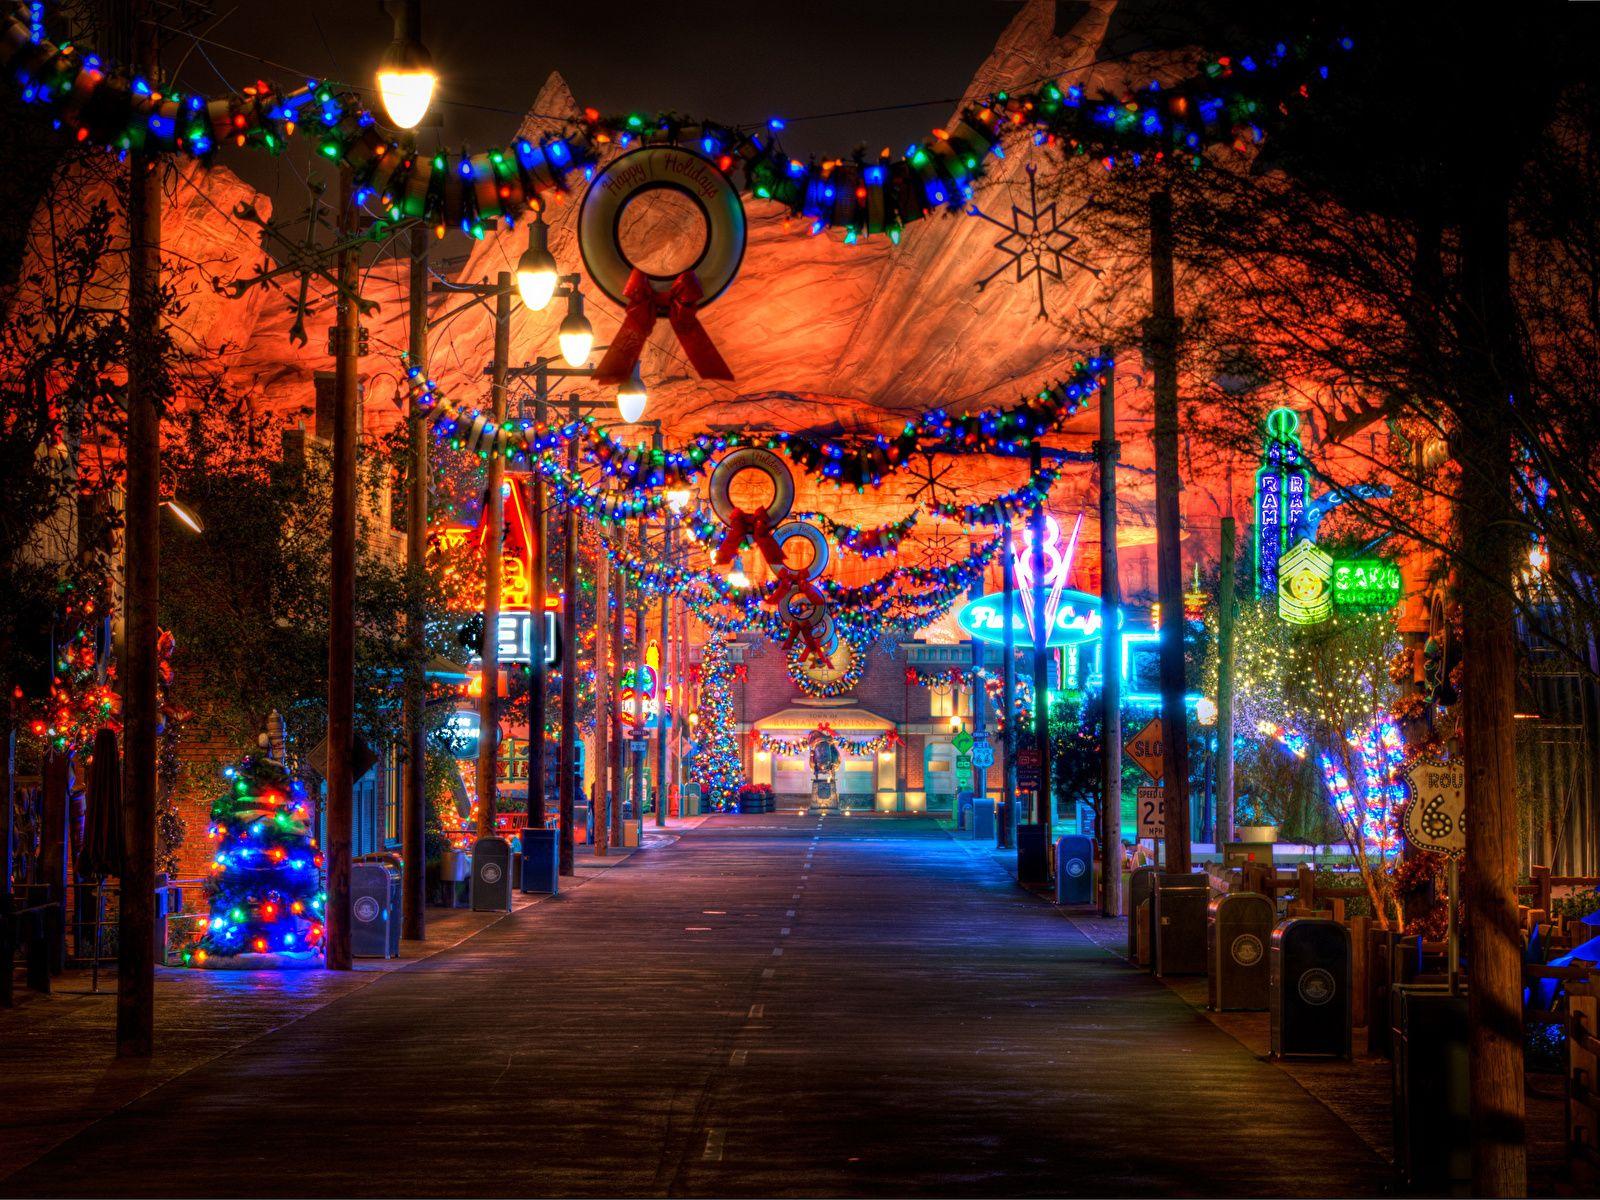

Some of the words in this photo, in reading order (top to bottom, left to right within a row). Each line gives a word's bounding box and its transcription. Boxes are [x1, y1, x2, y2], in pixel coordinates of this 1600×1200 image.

[602, 163, 648, 198] Happy
[664, 153, 719, 199] Holidays
[1335, 566, 1400, 590] SARG
[1134, 741, 1164, 758] SLO
[1427, 773, 1464, 789] ROU
[1139, 790, 1158, 799] SPEED
[1420, 794, 1466, 836] 6
[1148, 827, 1164, 835] MPH
